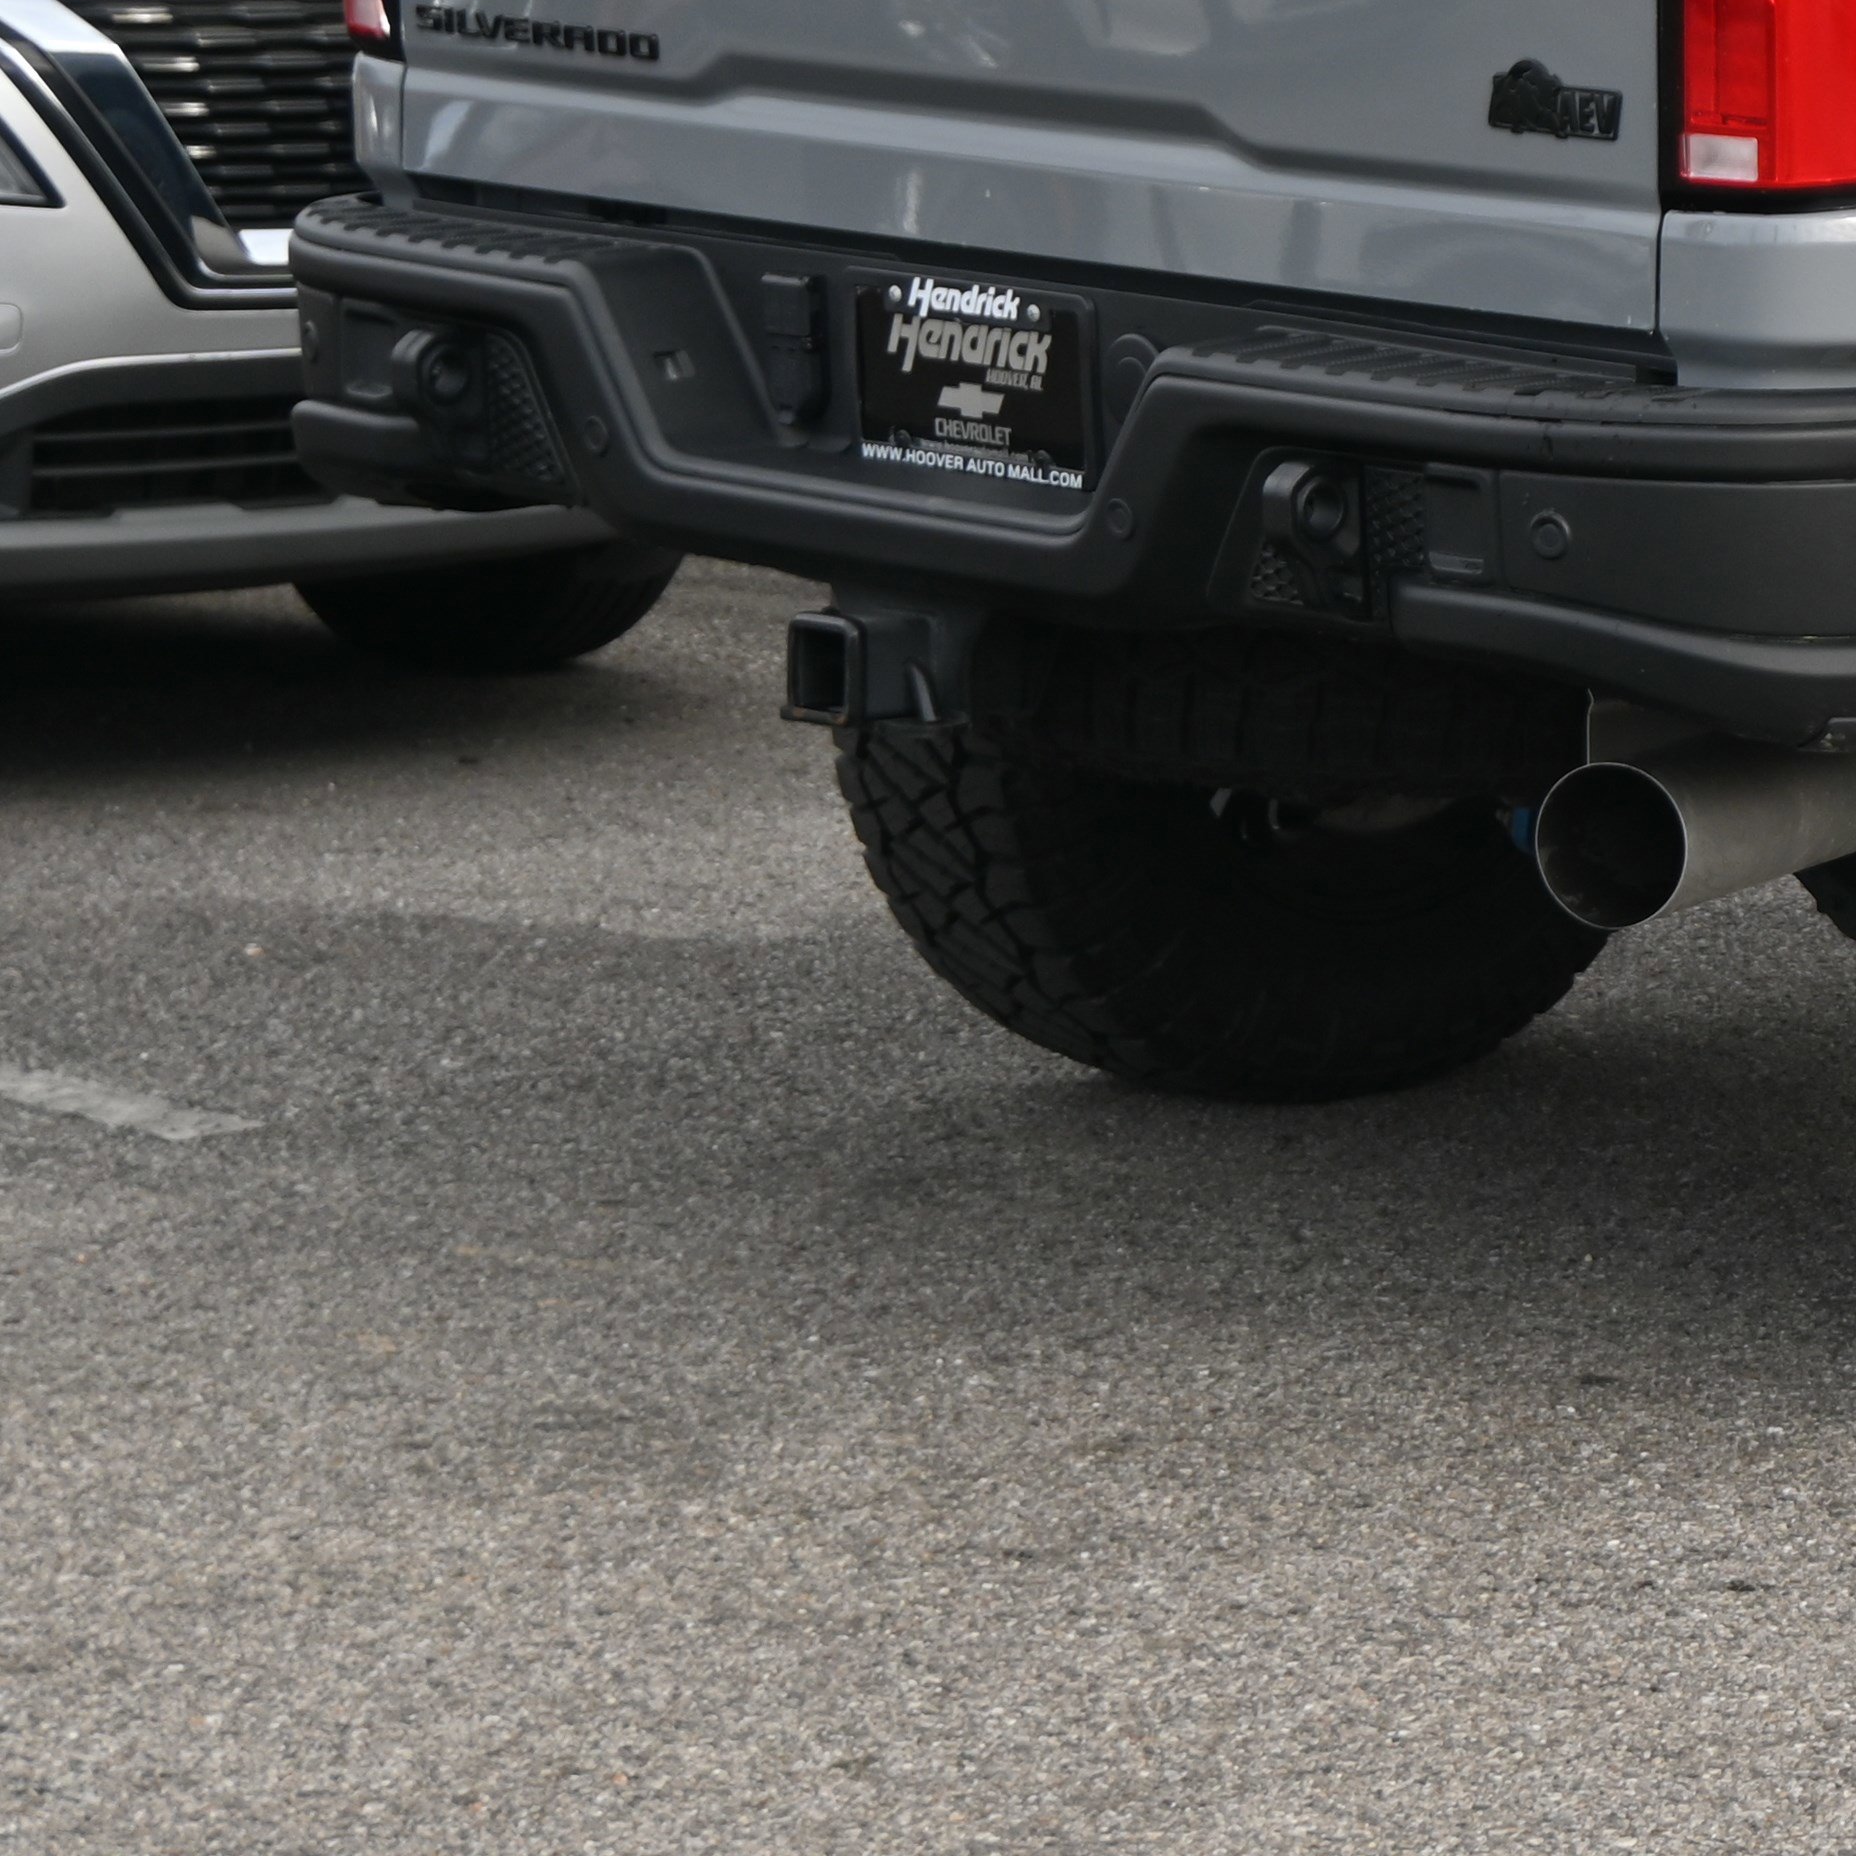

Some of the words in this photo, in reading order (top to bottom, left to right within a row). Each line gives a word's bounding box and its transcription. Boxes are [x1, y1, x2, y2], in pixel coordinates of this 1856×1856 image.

[415, 4, 660, 61] SILVERADO
[1556, 90, 1618, 136] AEV
[907, 275, 1022, 321] Hendrick
[887, 313, 1052, 375] Hendrick
[934, 417, 1013, 446] CHEVROLET
[861, 442, 964, 471] WWW.HOOVER
[965, 457, 1006, 477] AUTO
[1007, 463, 1083, 489] MALL.COM
